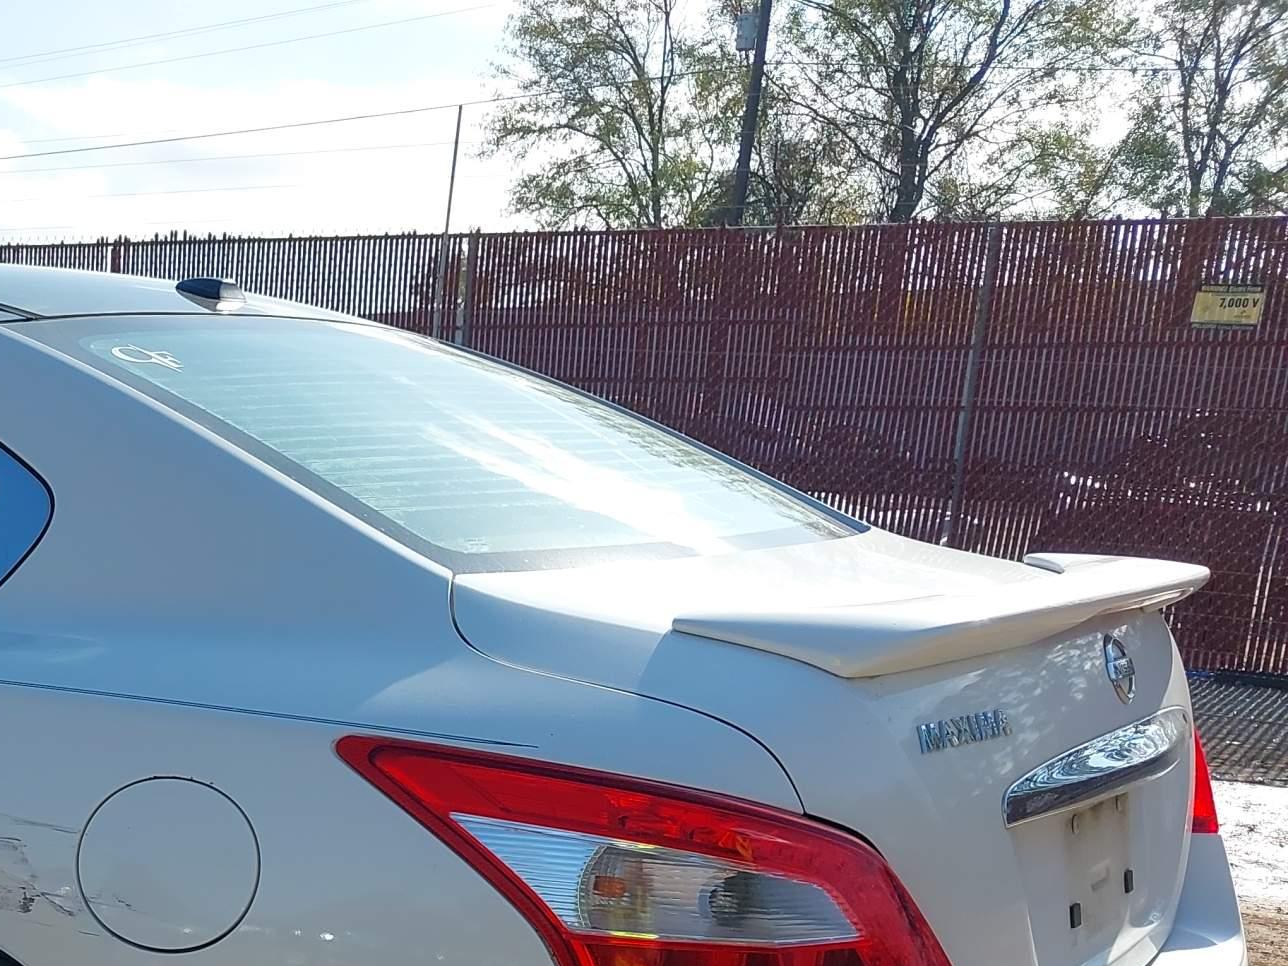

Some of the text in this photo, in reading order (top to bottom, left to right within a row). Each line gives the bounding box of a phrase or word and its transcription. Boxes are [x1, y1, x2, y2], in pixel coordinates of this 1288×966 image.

[1218, 298, 1260, 309] 7,000 V
[916, 708, 1012, 754] MAXIMA
